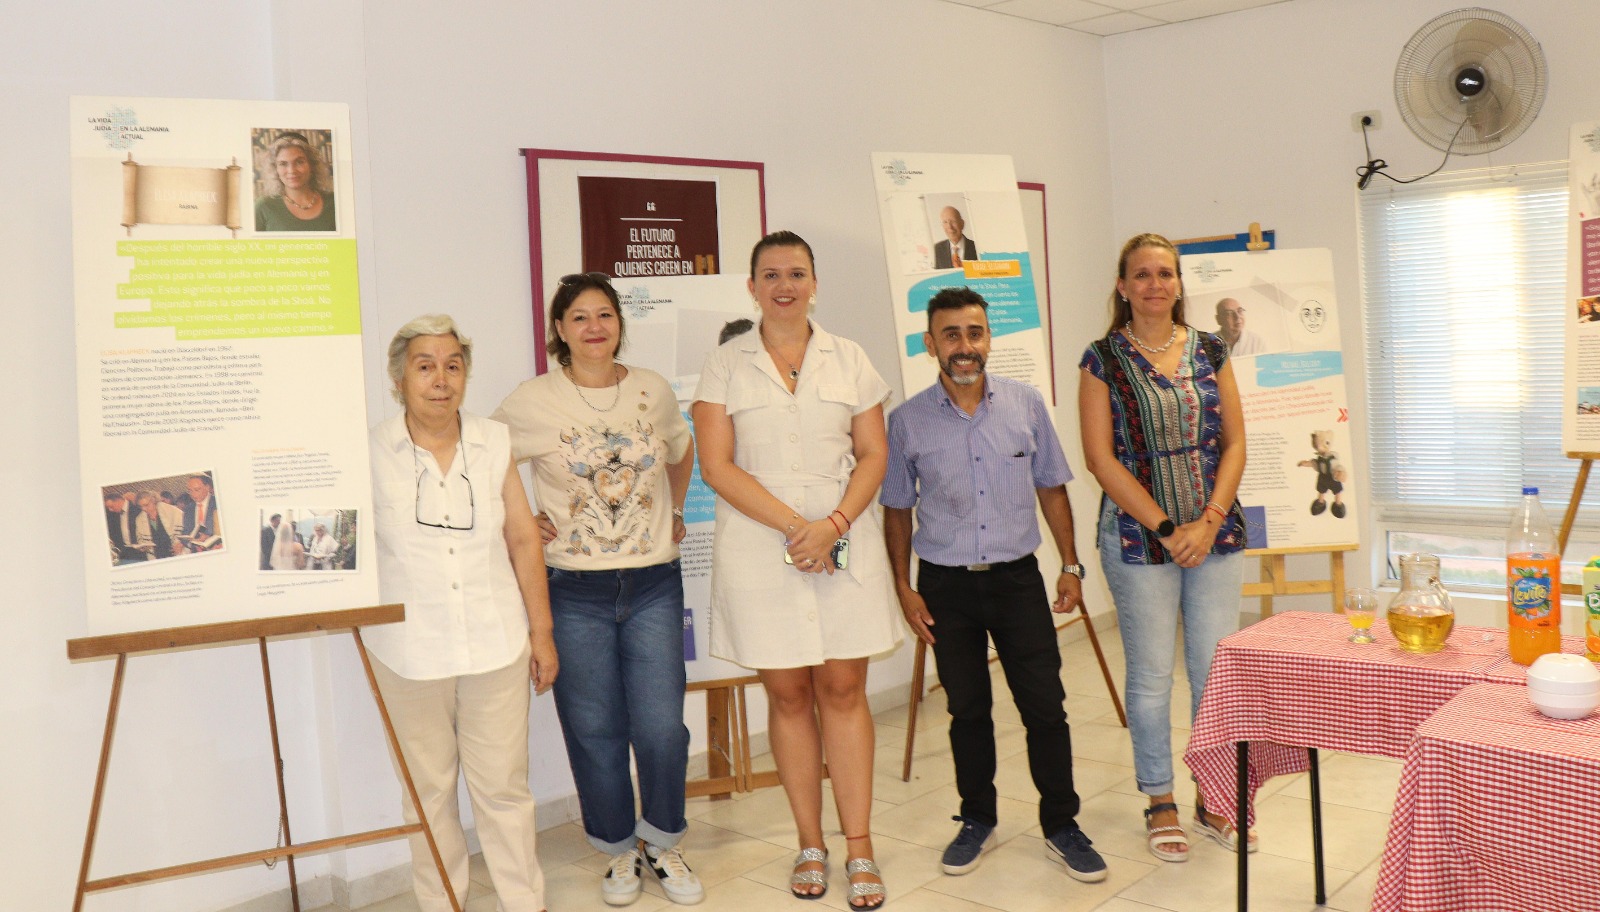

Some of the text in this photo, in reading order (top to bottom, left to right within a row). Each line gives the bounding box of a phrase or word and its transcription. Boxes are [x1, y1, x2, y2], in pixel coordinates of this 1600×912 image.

[630, 228, 676, 242] EL FUTURO
[171, 243, 186, 252] del
[187, 243, 222, 251] horrible
[225, 242, 246, 254] siglo
[278, 242, 328, 254] generación
[627, 244, 681, 259] PERTENECE A
[137, 258, 149, 266] ha
[152, 258, 197, 266] intentado
[226, 257, 243, 265] una
[275, 255, 329, 267] perspectiva
[615, 260, 694, 277] QUIENES CREEN EN
[134, 272, 170, 282] positiva
[172, 272, 194, 282] para
[208, 271, 226, 279] vida
[229, 270, 251, 280] judía
[266, 270, 308, 278] Alemania
[310, 271, 317, 280] y
[119, 286, 155, 297] Europa.
[183, 285, 222, 296] significa
[224, 285, 241, 294] que
[243, 285, 266, 294] poco
[276, 284, 298, 294] poco
[154, 300, 191, 311] dejando
[193, 298, 218, 307] atrás
[220, 299, 228, 307] la
[231, 297, 266, 306] sombra
[268, 298, 279, 306] de
[281, 297, 290, 305] la
[318, 296, 332, 304] No
[117, 310, 332, 323] olvidamos los crímenes, pero al mismo tiempo
[178, 326, 246, 338] emprendemos
